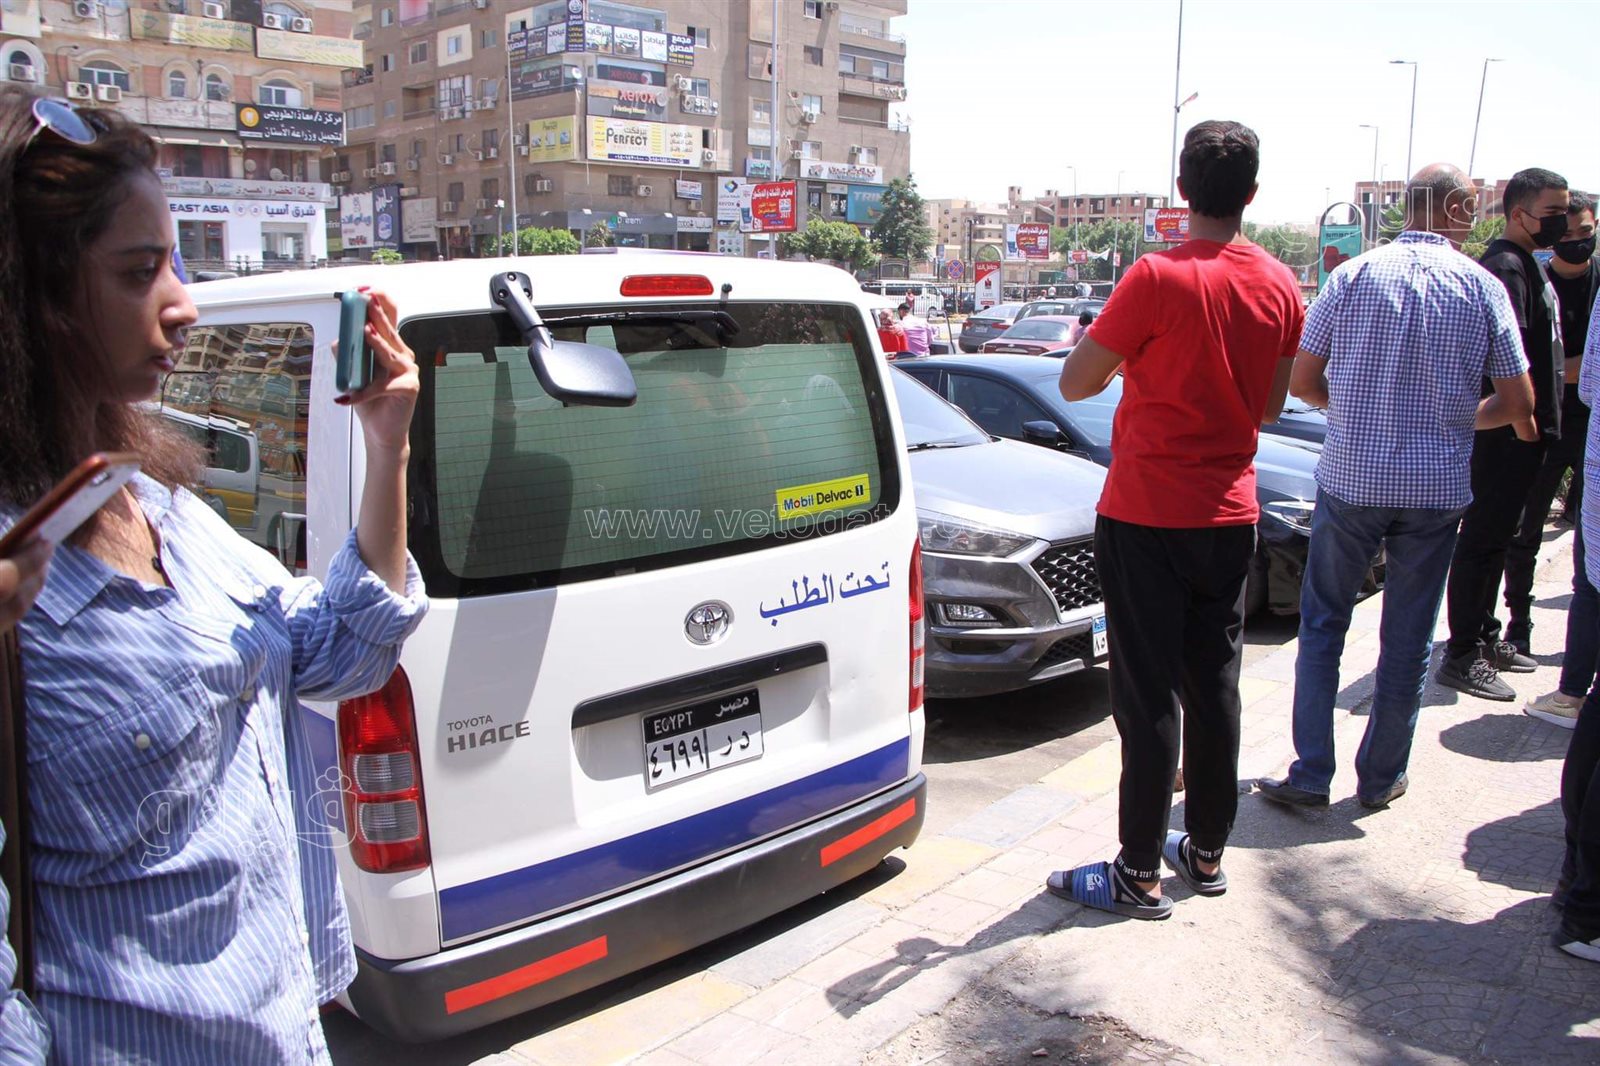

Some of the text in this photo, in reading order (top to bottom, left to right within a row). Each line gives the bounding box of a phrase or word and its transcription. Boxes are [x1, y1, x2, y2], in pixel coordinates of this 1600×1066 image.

[619, 88, 656, 104] xerox
[323, 111, 342, 125] مركز
[264, 123, 290, 137] الأسنان
[290, 126, 317, 142] وزراعة
[317, 132, 342, 143] لتجميل
[606, 127, 648, 146] PERFECT
[169, 203, 229, 214] EAST ASIA
[292, 203, 316, 218] شرق
[783, 496, 814, 512] Mobil
[816, 487, 853, 506] Delvac
[759, 560, 890, 627] تحت الطلب
[714, 695, 750, 718] مصر
[447, 714, 494, 732] TOYOTA
[653, 710, 693, 736] EGYPT
[447, 720, 531, 753] HIACE
